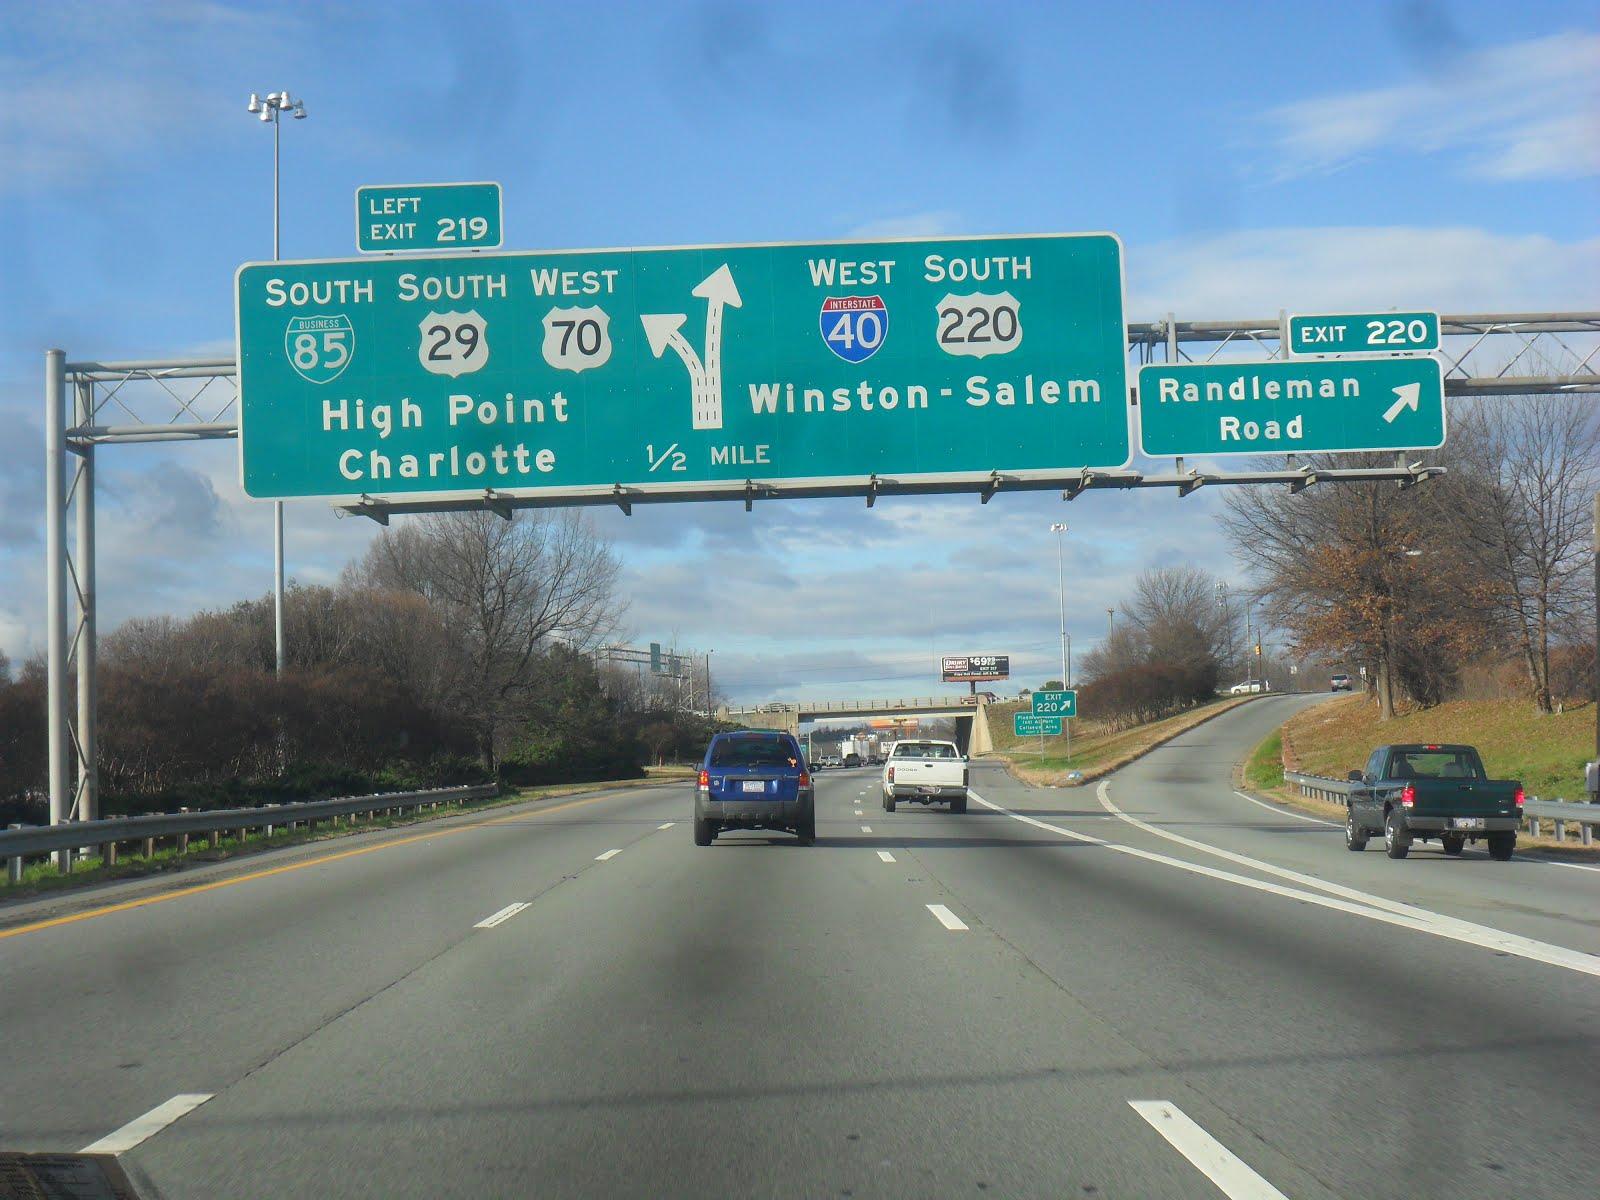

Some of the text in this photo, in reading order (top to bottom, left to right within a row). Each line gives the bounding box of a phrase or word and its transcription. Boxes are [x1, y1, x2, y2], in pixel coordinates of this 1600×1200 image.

[371, 197, 421, 215] LEFT
[371, 217, 488, 241] EXIT 219
[531, 268, 619, 296] WEST
[809, 258, 896, 287] WEST
[925, 255, 1032, 283] SOUTH
[265, 279, 373, 307] SOUTH
[398, 273, 507, 302] SOUTH
[830, 299, 876, 309] INTERSTATE
[299, 319, 339, 329] BUSINESS
[551, 320, 602, 356] 70
[828, 312, 881, 348] 40
[940, 306, 1017, 343] 220
[1301, 319, 1428, 345] EXIT 220
[294, 332, 347, 369] 85
[428, 324, 479, 361] 29
[1159, 376, 1360, 403] Randleman
[322, 392, 568, 438] High Point
[1221, 415, 1303, 441] Road
[339, 444, 556, 480] Charlotte
[646, 443, 770, 471] 1/2 MILE
[1037, 703, 1057, 712] 220
